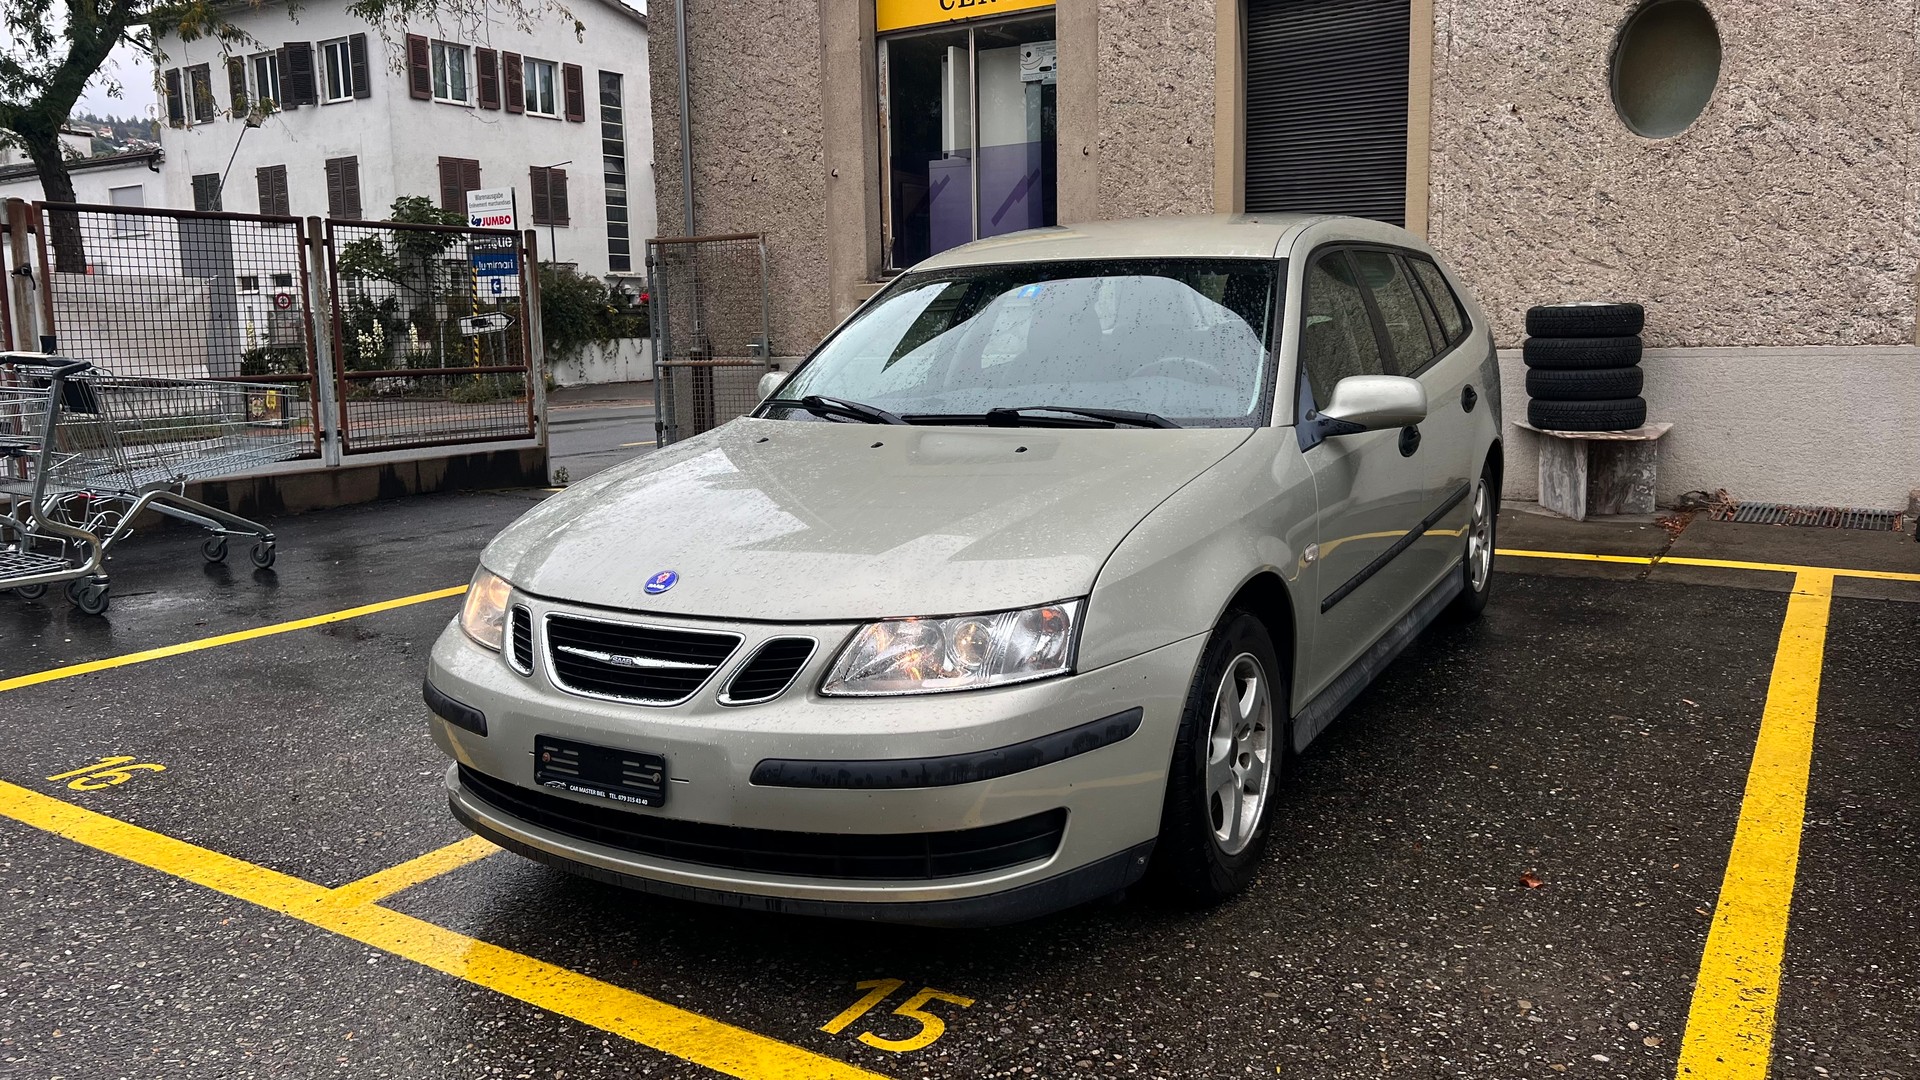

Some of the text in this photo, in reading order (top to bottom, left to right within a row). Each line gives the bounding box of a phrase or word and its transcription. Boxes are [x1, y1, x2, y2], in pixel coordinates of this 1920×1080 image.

[482, 215, 511, 227] JUMBO
[611, 656, 632, 665] SAAB
[46, 755, 167, 792] 16
[579, 787, 596, 795] MASTER
[819, 977, 977, 1053] 15
